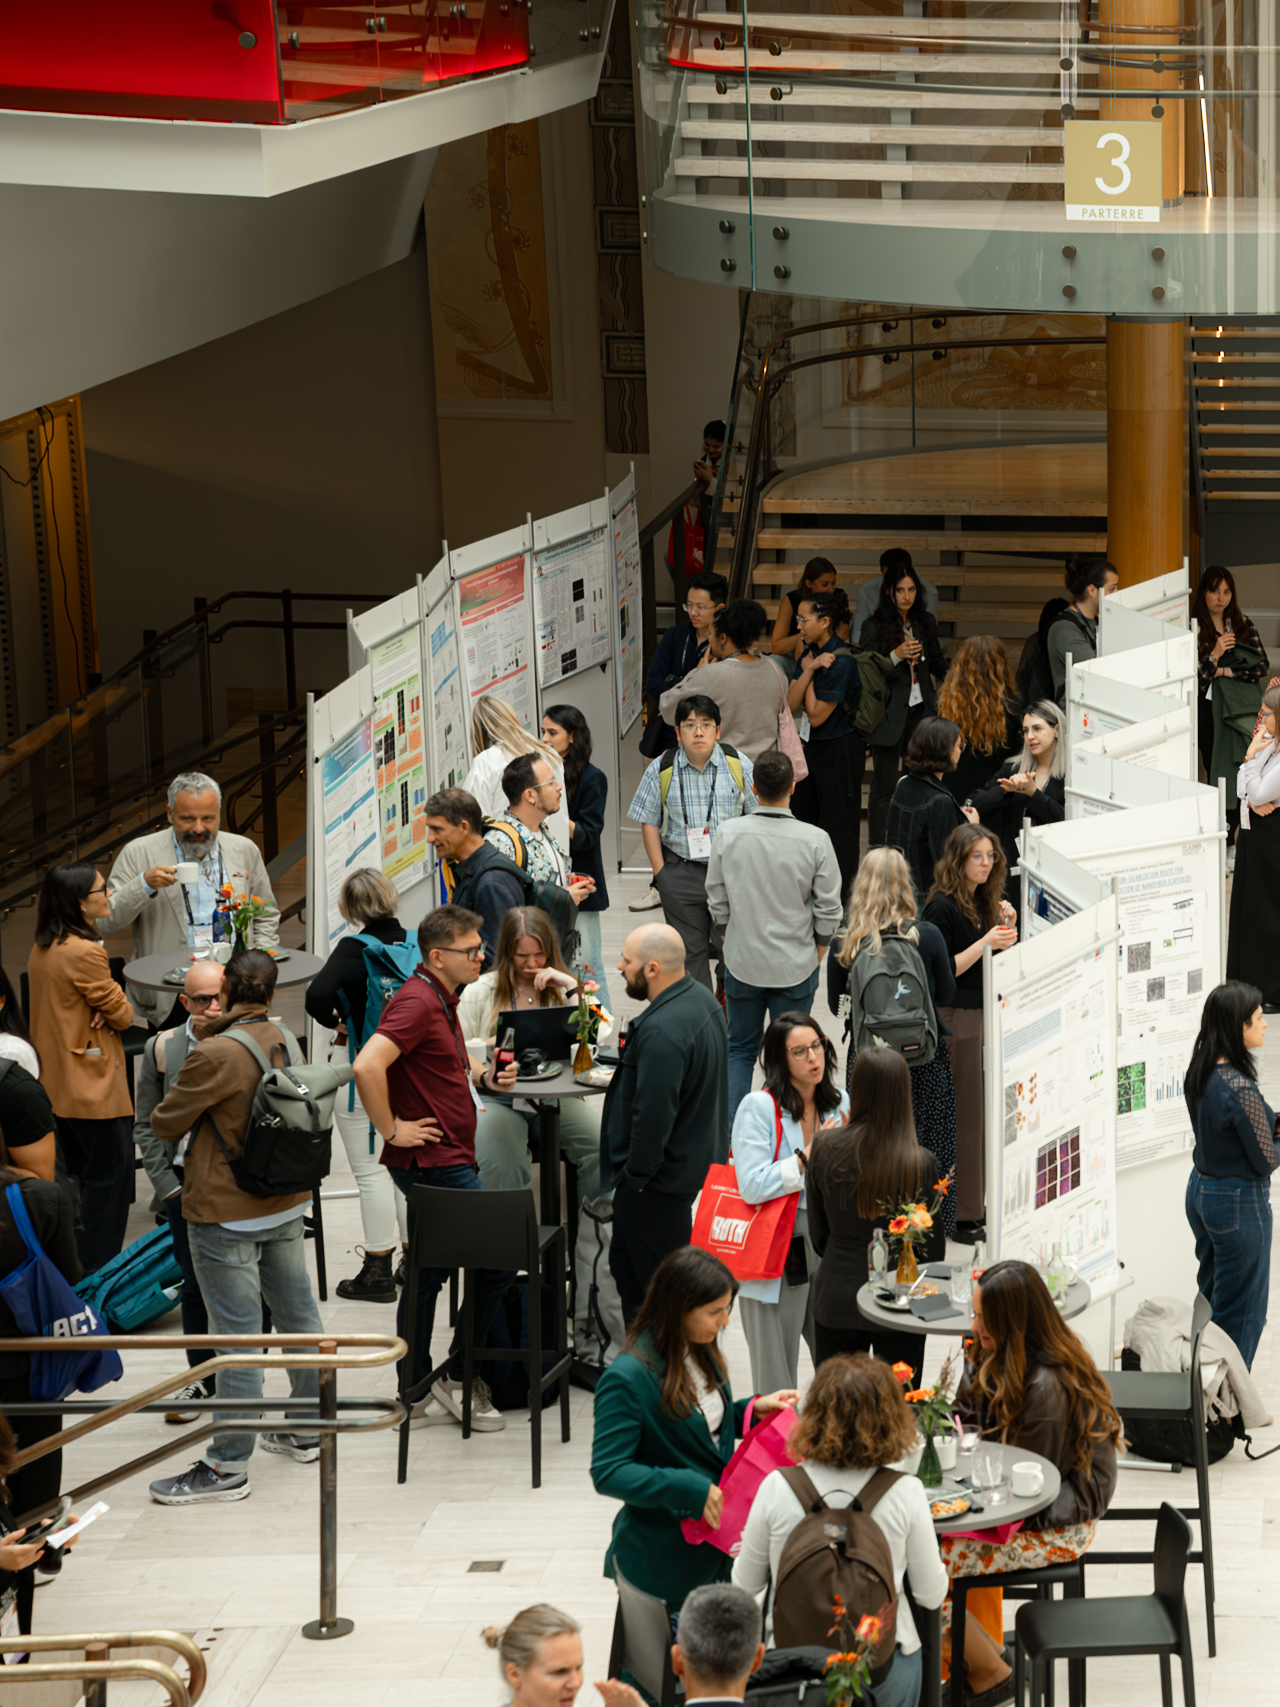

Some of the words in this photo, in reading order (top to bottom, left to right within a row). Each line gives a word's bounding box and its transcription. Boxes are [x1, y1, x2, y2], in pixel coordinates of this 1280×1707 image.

[1094, 132, 1131, 195] 3
[1081, 207, 1144, 220] PARTERRE
[711, 1215, 750, 1244] ROTH
